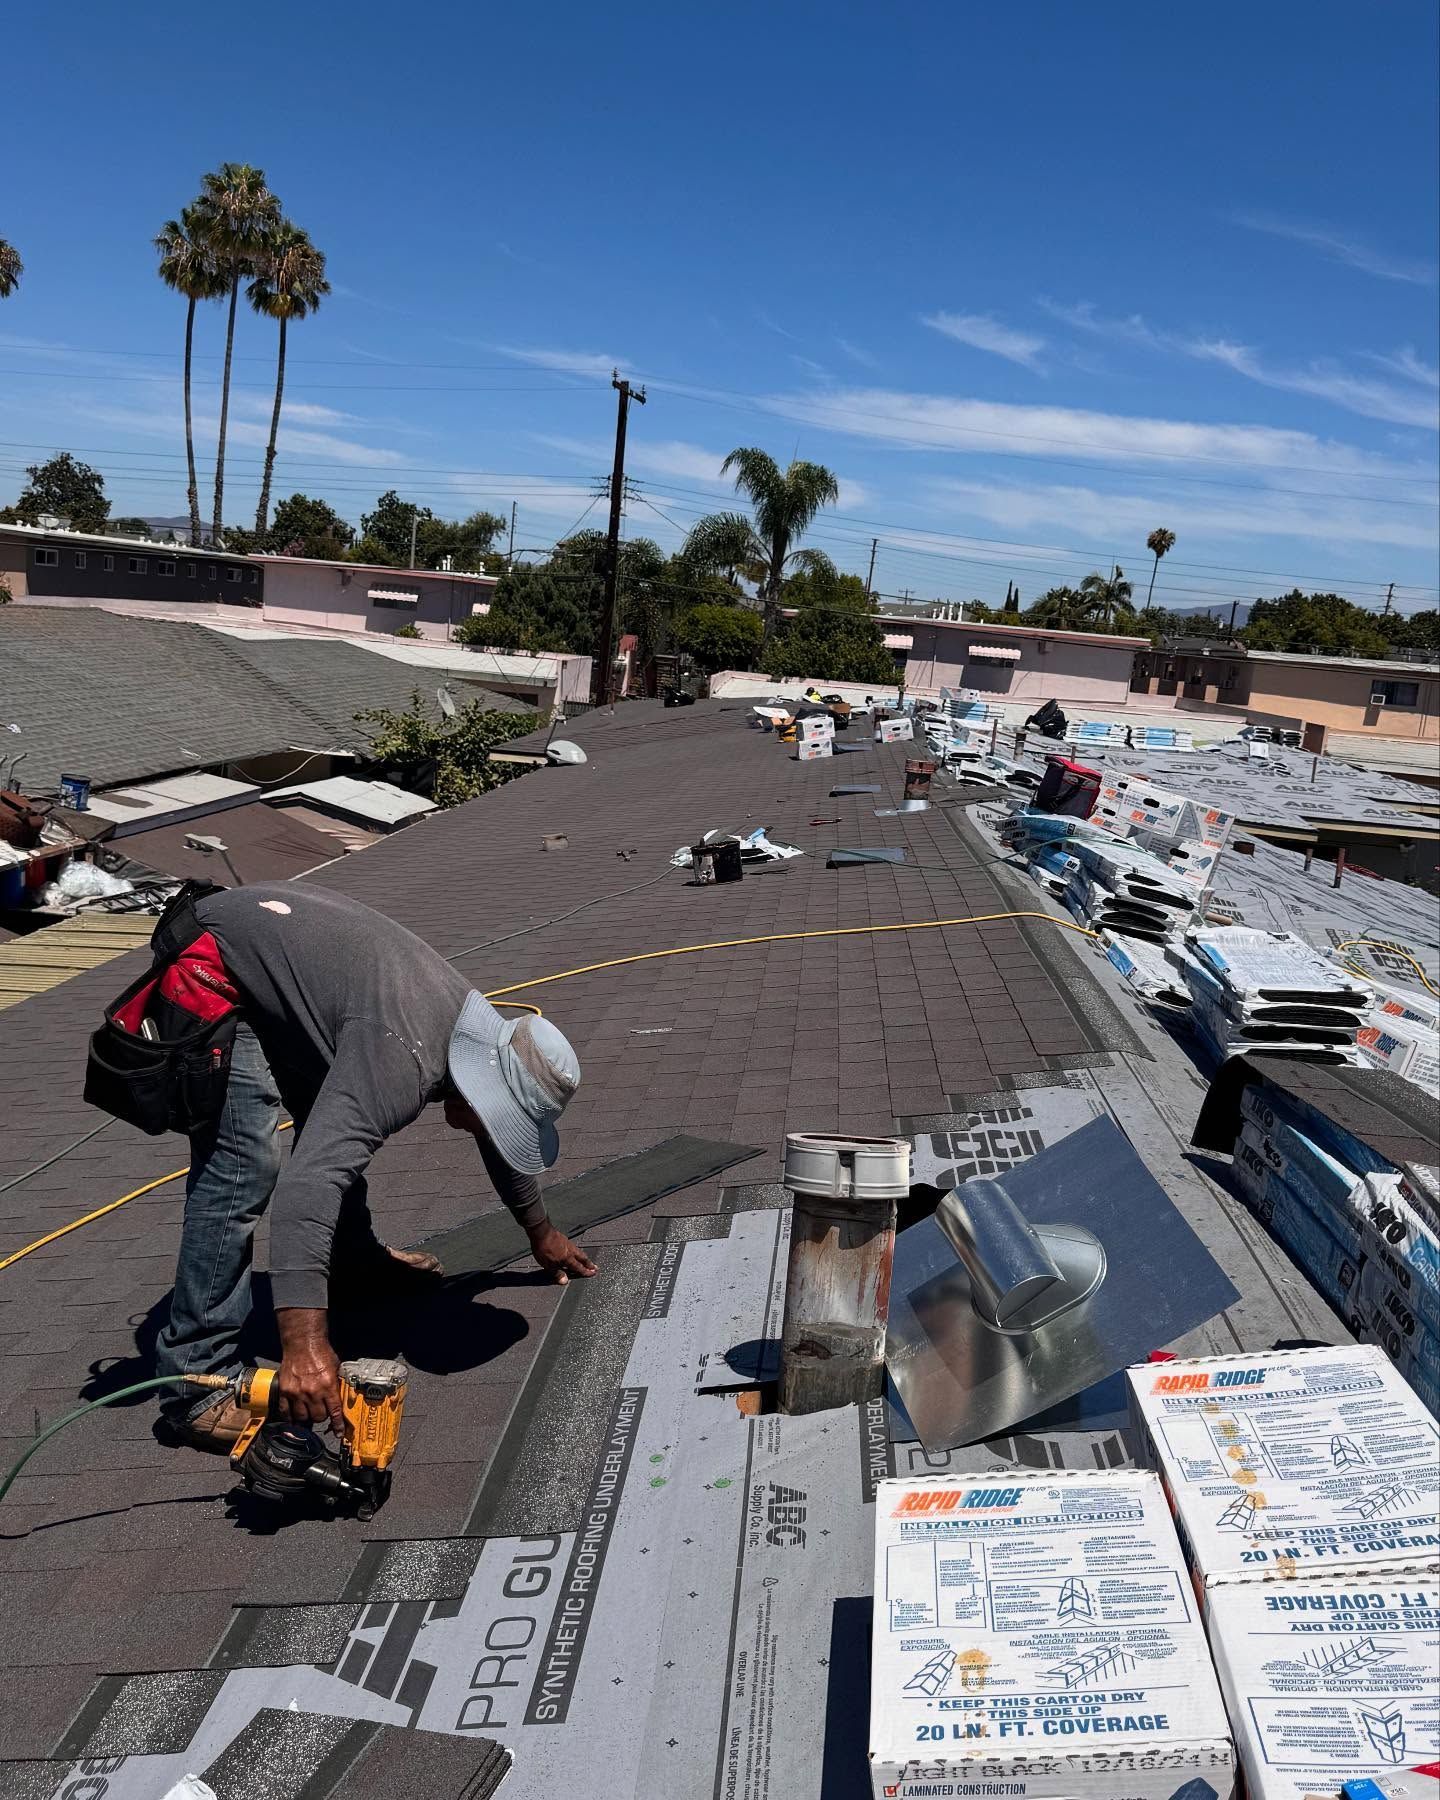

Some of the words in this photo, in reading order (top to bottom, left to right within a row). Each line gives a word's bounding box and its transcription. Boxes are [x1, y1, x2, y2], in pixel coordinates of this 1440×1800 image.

[1284, 800, 1335, 810] ABC
[1363, 808, 1414, 817] ABC
[1376, 1033, 1399, 1055] RIDGE
[648, 1266, 673, 1318] SYNTHETIC
[1153, 1373, 1209, 1390] RAPID
[1211, 1367, 1268, 1387] RIDGE
[1163, 1392, 1266, 1405] INSTALLATION
[1272, 1380, 1383, 1398] INSTRUCTIONS
[749, 1485, 766, 1514] Supply
[896, 1490, 962, 1511] RAPID
[962, 1487, 1025, 1508] RIDGE
[749, 1515, 764, 1529] Co.
[765, 1480, 807, 1550] ABC
[901, 1519, 1016, 1530] INSTALLATION
[1021, 1510, 1141, 1525] INSTRUCTIONS
[1253, 1529, 1295, 1540] KEEP
[1298, 1526, 1338, 1537] THIS
[1339, 1520, 1403, 1533] CARTON
[1406, 1515, 1437, 1525] DRY
[1297, 1535, 1338, 1545] THIS
[1340, 1531, 1380, 1542] SIDE
[1382, 1529, 1403, 1538] UP
[535, 1598, 585, 1720] SYNTHETIC
[573, 1512, 607, 1592] ROOFING
[598, 1389, 641, 1508] UNDERLAYMENT
[1240, 1550, 1268, 1563] 20
[1272, 1546, 1310, 1560] LN.
[1316, 1543, 1349, 1557] FT.
[1354, 1533, 1440, 1553] COVERA
[1264, 1593, 1387, 1612] COVERAGE
[1391, 1591, 1429, 1608] FT.
[1331, 1610, 1356, 1621] UP
[1358, 1611, 1400, 1620] SIDE
[1402, 1610, 1440, 1619] THIS
[1290, 1623, 1324, 1632] DRY
[1329, 1621, 1400, 1632] CARTON
[1402, 1620, 1440, 1630] THIS
[1127, 1633, 1171, 1641] OPCIONAL
[455, 1616, 537, 1730] PRO
[738, 1651, 748, 1683] OVERLAP
[735, 1682, 746, 1699] LINE
[1392, 1684, 1424, 1692] GABLE
[939, 1699, 985, 1709] KEEP
[989, 1697, 1030, 1707] THIS
[1034, 1693, 1106, 1706] CARTON
[1111, 1691, 1145, 1702] DRY
[987, 1709, 1028, 1719] THIS
[1033, 1707, 1073, 1717] SIDE
[1078, 1706, 1102, 1715] UP
[916, 1724, 945, 1741] 20
[953, 1722, 991, 1739] LN.
[999, 1721, 1034, 1737] FT.
[1042, 1714, 1170, 1736] COVERAGE
[729, 1751, 739, 1761] DE
[981, 1762, 1062, 1778] BLACK
[902, 1784, 954, 1797] LAMINATED
[957, 1783, 1026, 1796] CONSTRUCTION
